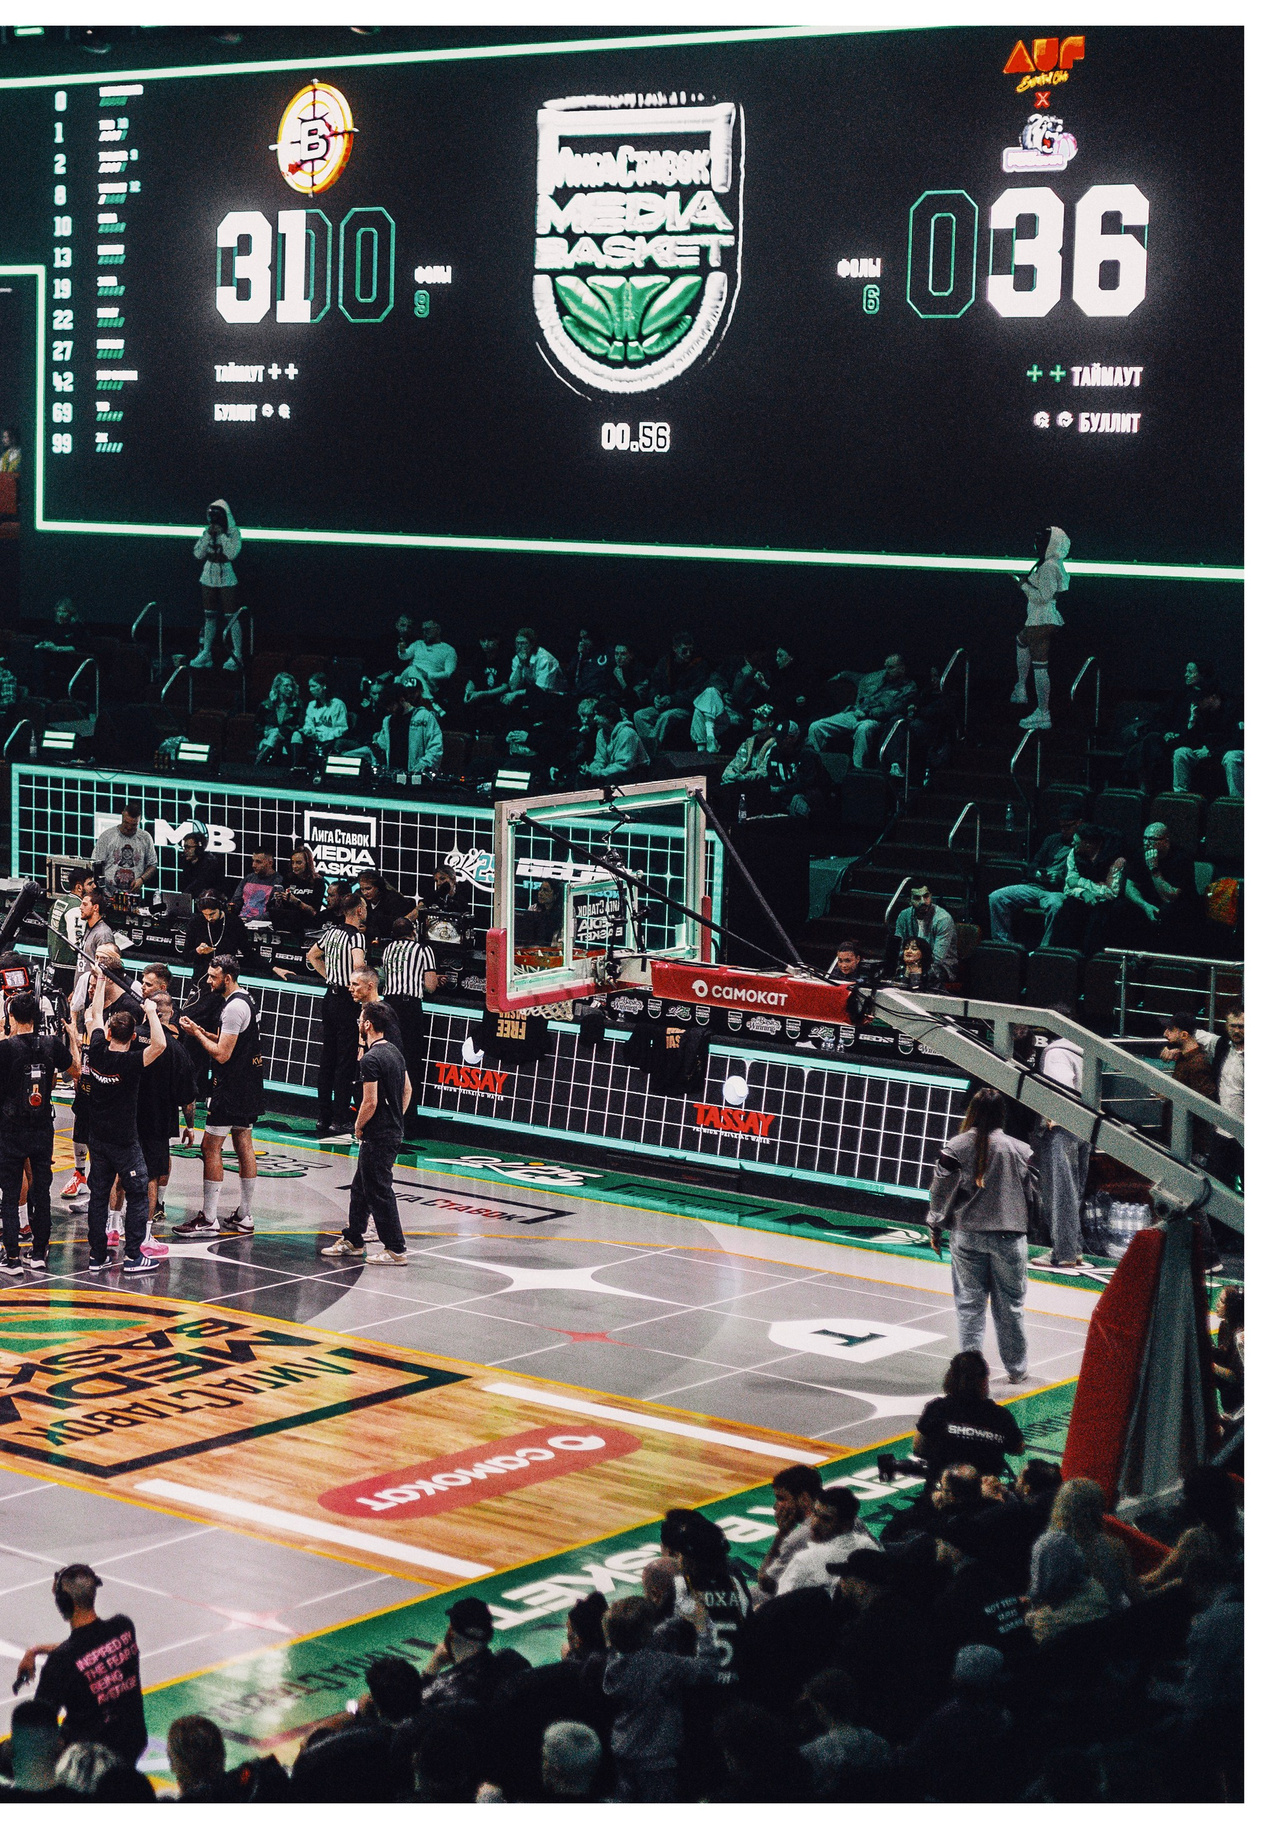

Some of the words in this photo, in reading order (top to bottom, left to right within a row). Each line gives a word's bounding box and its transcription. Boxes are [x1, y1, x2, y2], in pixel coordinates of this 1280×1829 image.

[54, 122, 64, 143] 1
[54, 153, 66, 174] 2
[536, 191, 734, 234] MEDIA
[54, 216, 72, 237] 10
[53, 247, 72, 267] 13
[535, 234, 735, 270] BASKET
[53, 278, 71, 299] 19
[862, 284, 880, 314] 6
[414, 290, 429, 318] 9
[52, 309, 73, 330] 22
[52, 340, 73, 361] 27
[52, 371, 74, 392] 42
[1071, 363, 1144, 387] ТАЙМАУТ
[52, 402, 73, 423] 69
[1078, 412, 1141, 433] БУЛЛИТ
[52, 433, 72, 453] 99
[601, 422, 670, 452] 00.56
[304, 843, 375, 865] MEDIA
[712, 981, 788, 1007] самокат
[496, 1021, 526, 1040] FREE
[435, 1062, 508, 1094] TASSAY
[693, 1103, 775, 1136] TASSAY
[420, 1197, 522, 1223] СТАВОК
[205, 1356, 348, 1394] ЛИГА
[14, 1387, 233, 1447] СТАВОК
[356, 1447, 556, 1512] самокат
[75, 1638, 122, 1672] INSPIRED
[120, 1630, 132, 1645] BY
[84, 1661, 108, 1682] THE
[106, 1646, 131, 1669] FEAR
